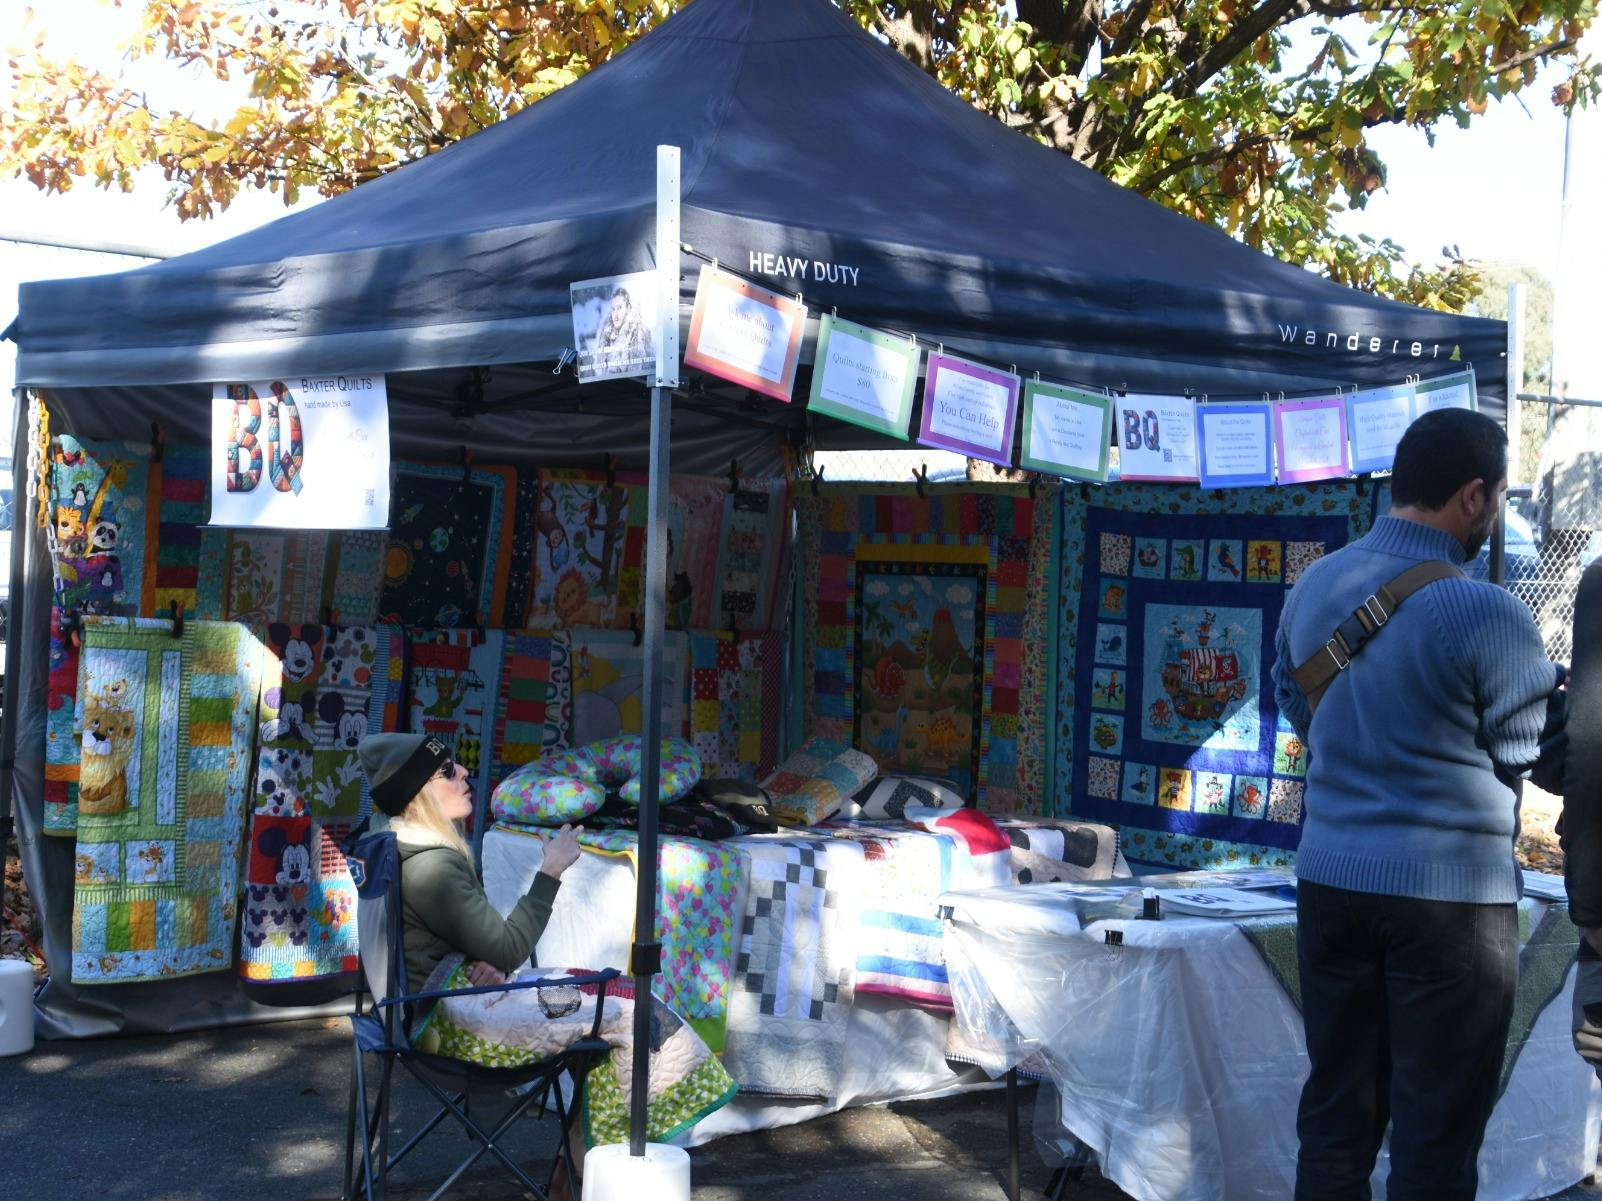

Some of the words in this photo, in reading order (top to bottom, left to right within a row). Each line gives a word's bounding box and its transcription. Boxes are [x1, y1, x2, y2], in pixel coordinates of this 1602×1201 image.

[749, 250, 808, 279] HEAVY
[813, 261, 859, 286] DUTY
[754, 316, 774, 333] about
[1278, 323, 1439, 358] Wanderer
[832, 352, 855, 368] Quilts
[855, 362, 882, 379] starting
[301, 377, 336, 394] BAXTER
[337, 375, 373, 392] QUILTS
[331, 400, 339, 410] by
[339, 399, 352, 408] Lisa
[940, 400, 957, 417] You
[959, 407, 977, 424] Can
[979, 412, 1000, 432] Help
[226, 380, 304, 497] BQ
[1122, 408, 1161, 453] BQ
